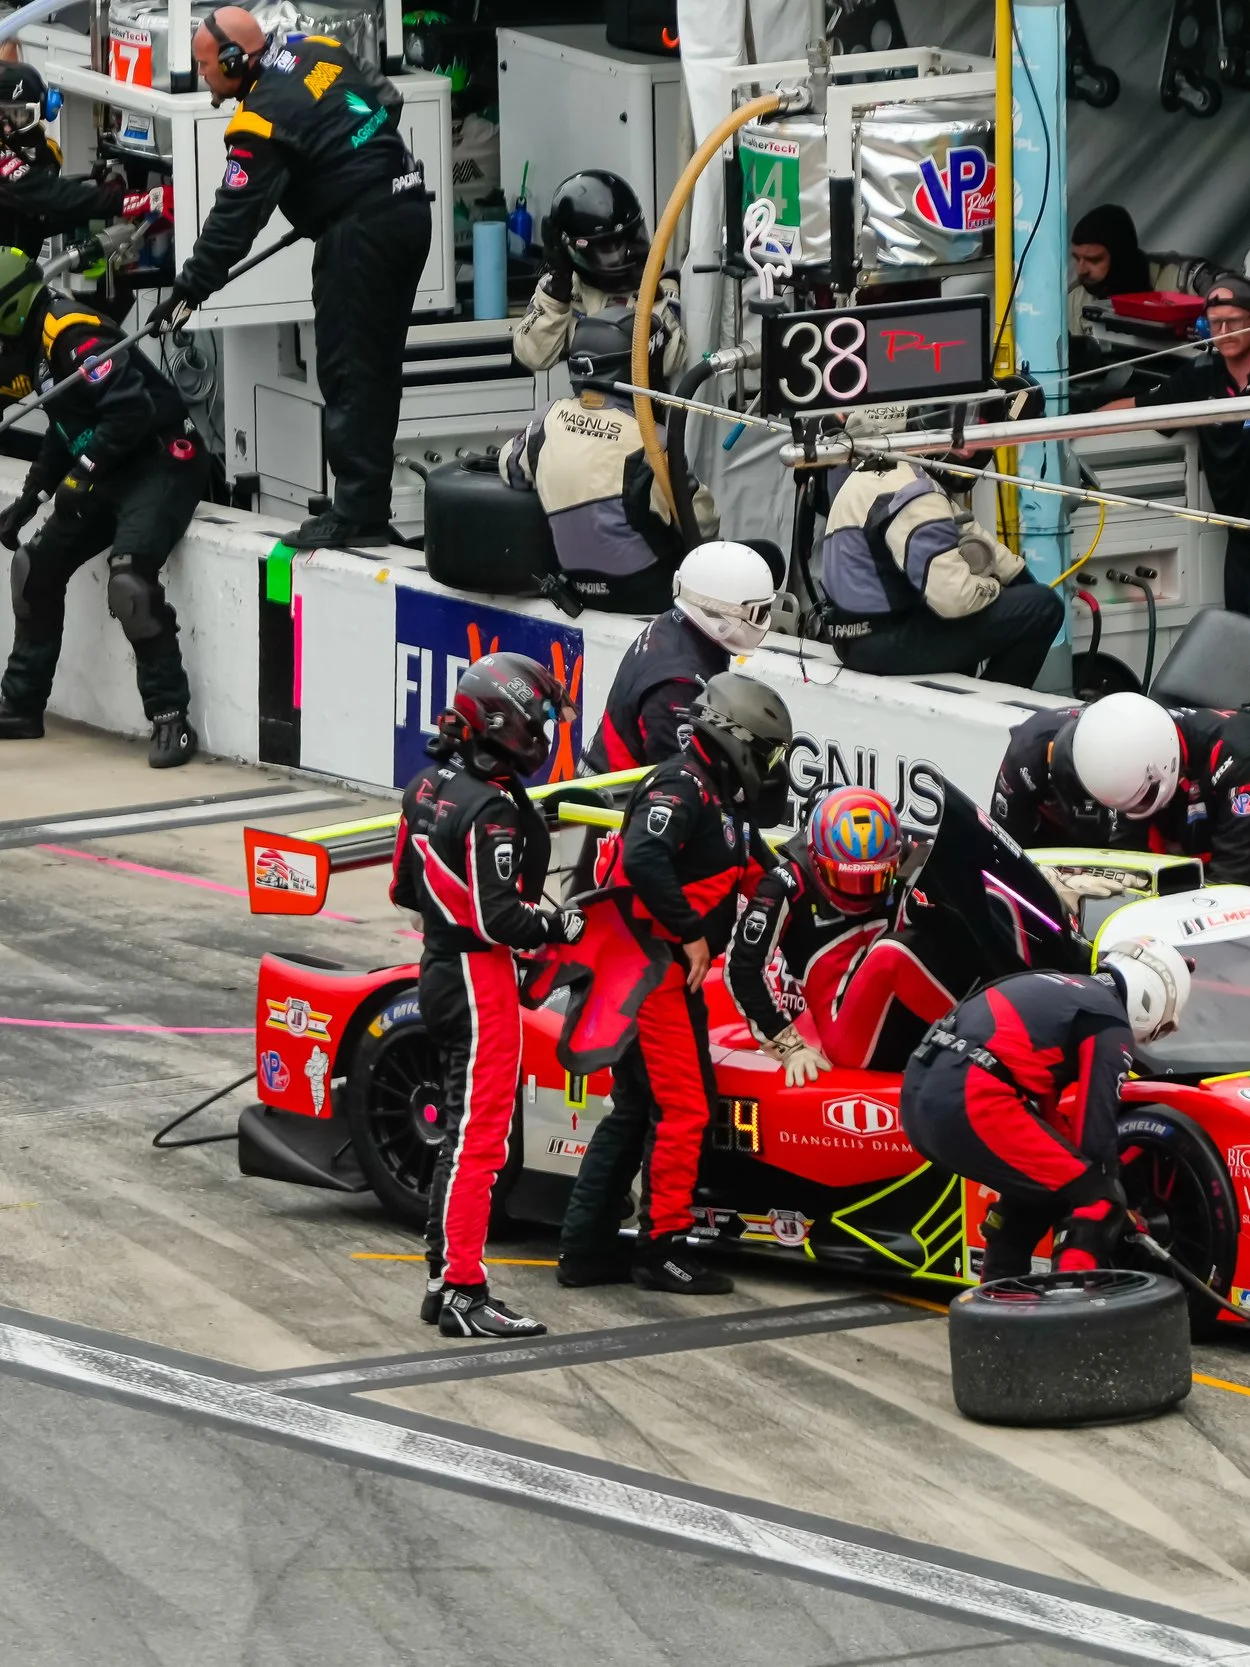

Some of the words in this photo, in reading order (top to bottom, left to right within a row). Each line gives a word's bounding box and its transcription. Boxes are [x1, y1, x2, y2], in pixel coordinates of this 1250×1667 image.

[779, 318, 869, 402] 38
[557, 410, 622, 434] MAGNUS
[1118, 1119, 1167, 1136] ICHELIN
[872, 1140, 914, 1153] DIAM
